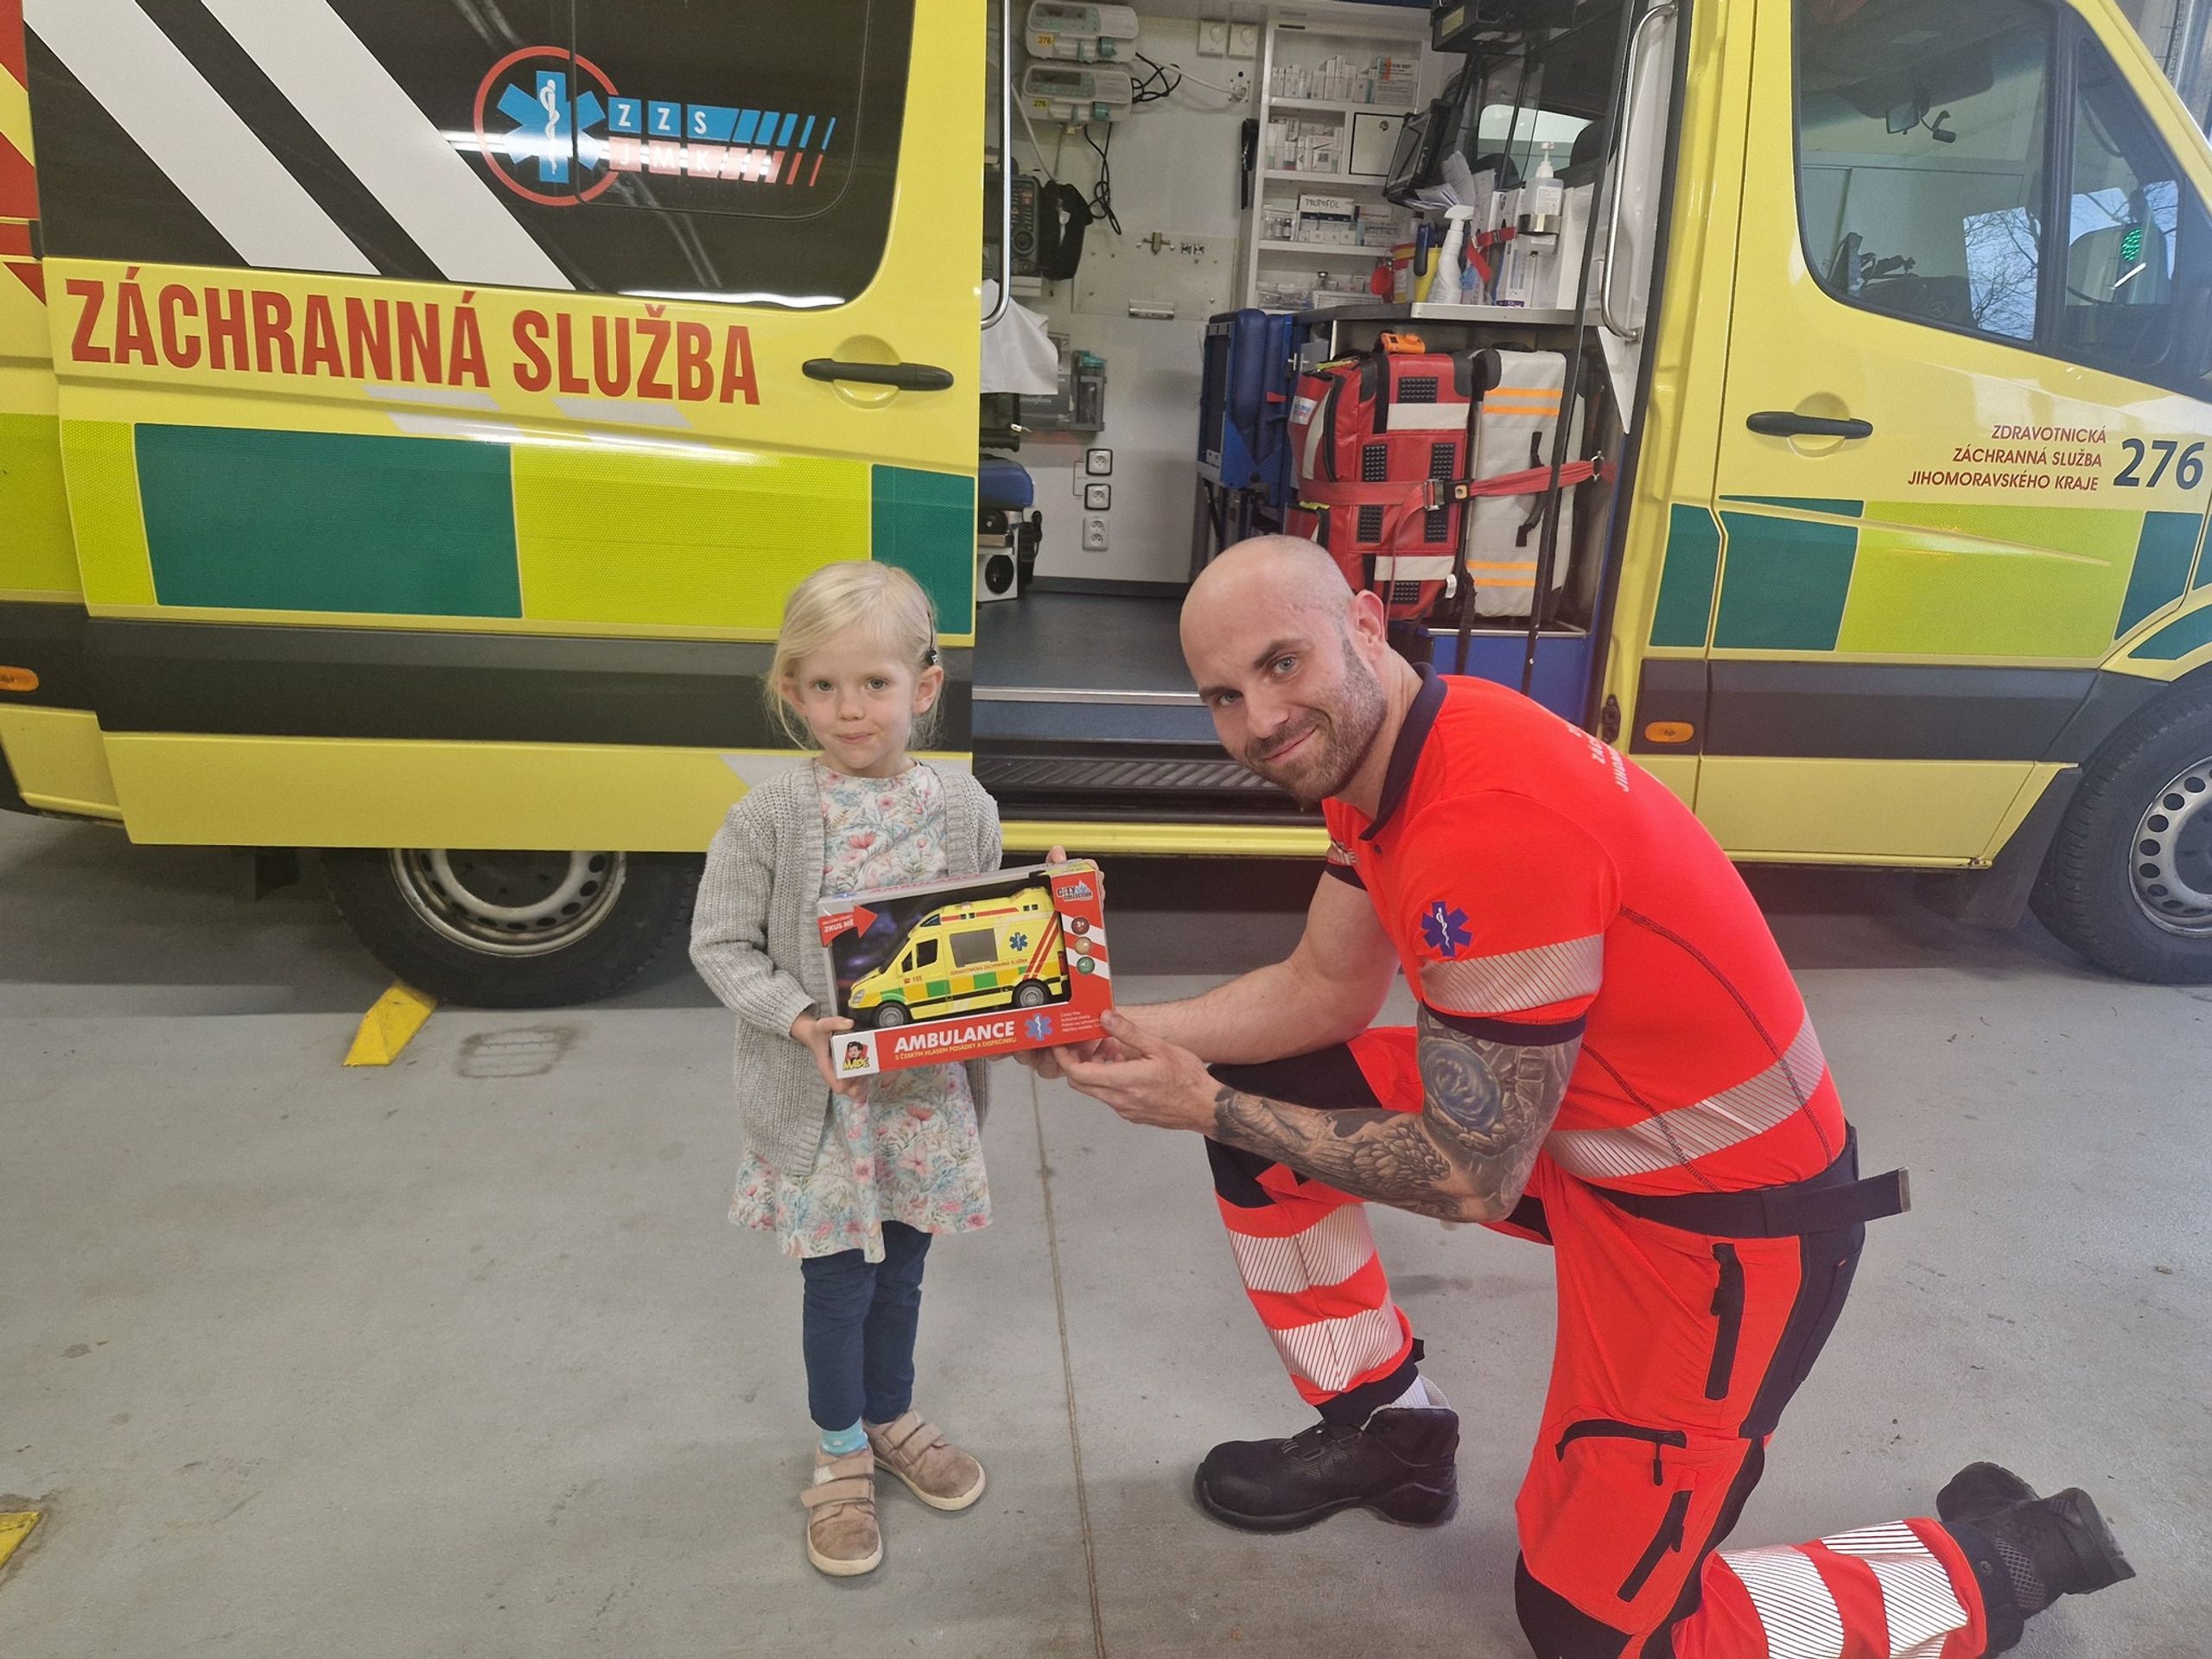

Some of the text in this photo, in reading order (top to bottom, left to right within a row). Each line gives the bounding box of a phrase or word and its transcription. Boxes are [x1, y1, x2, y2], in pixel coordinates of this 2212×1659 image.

[65, 266, 760, 405] ZÁCHRANNÁ SLUŽBA
[1992, 425, 2107, 443] ZDRAVOTNICKÁ
[1953, 447, 2102, 467] ZÁCHRANNÁ SLUŽBA
[2113, 438, 2205, 490] 276
[1908, 470, 2099, 491] JIHOMORAVSKÉHO KRAJE
[894, 1020, 1015, 1053] AMBULANCE
